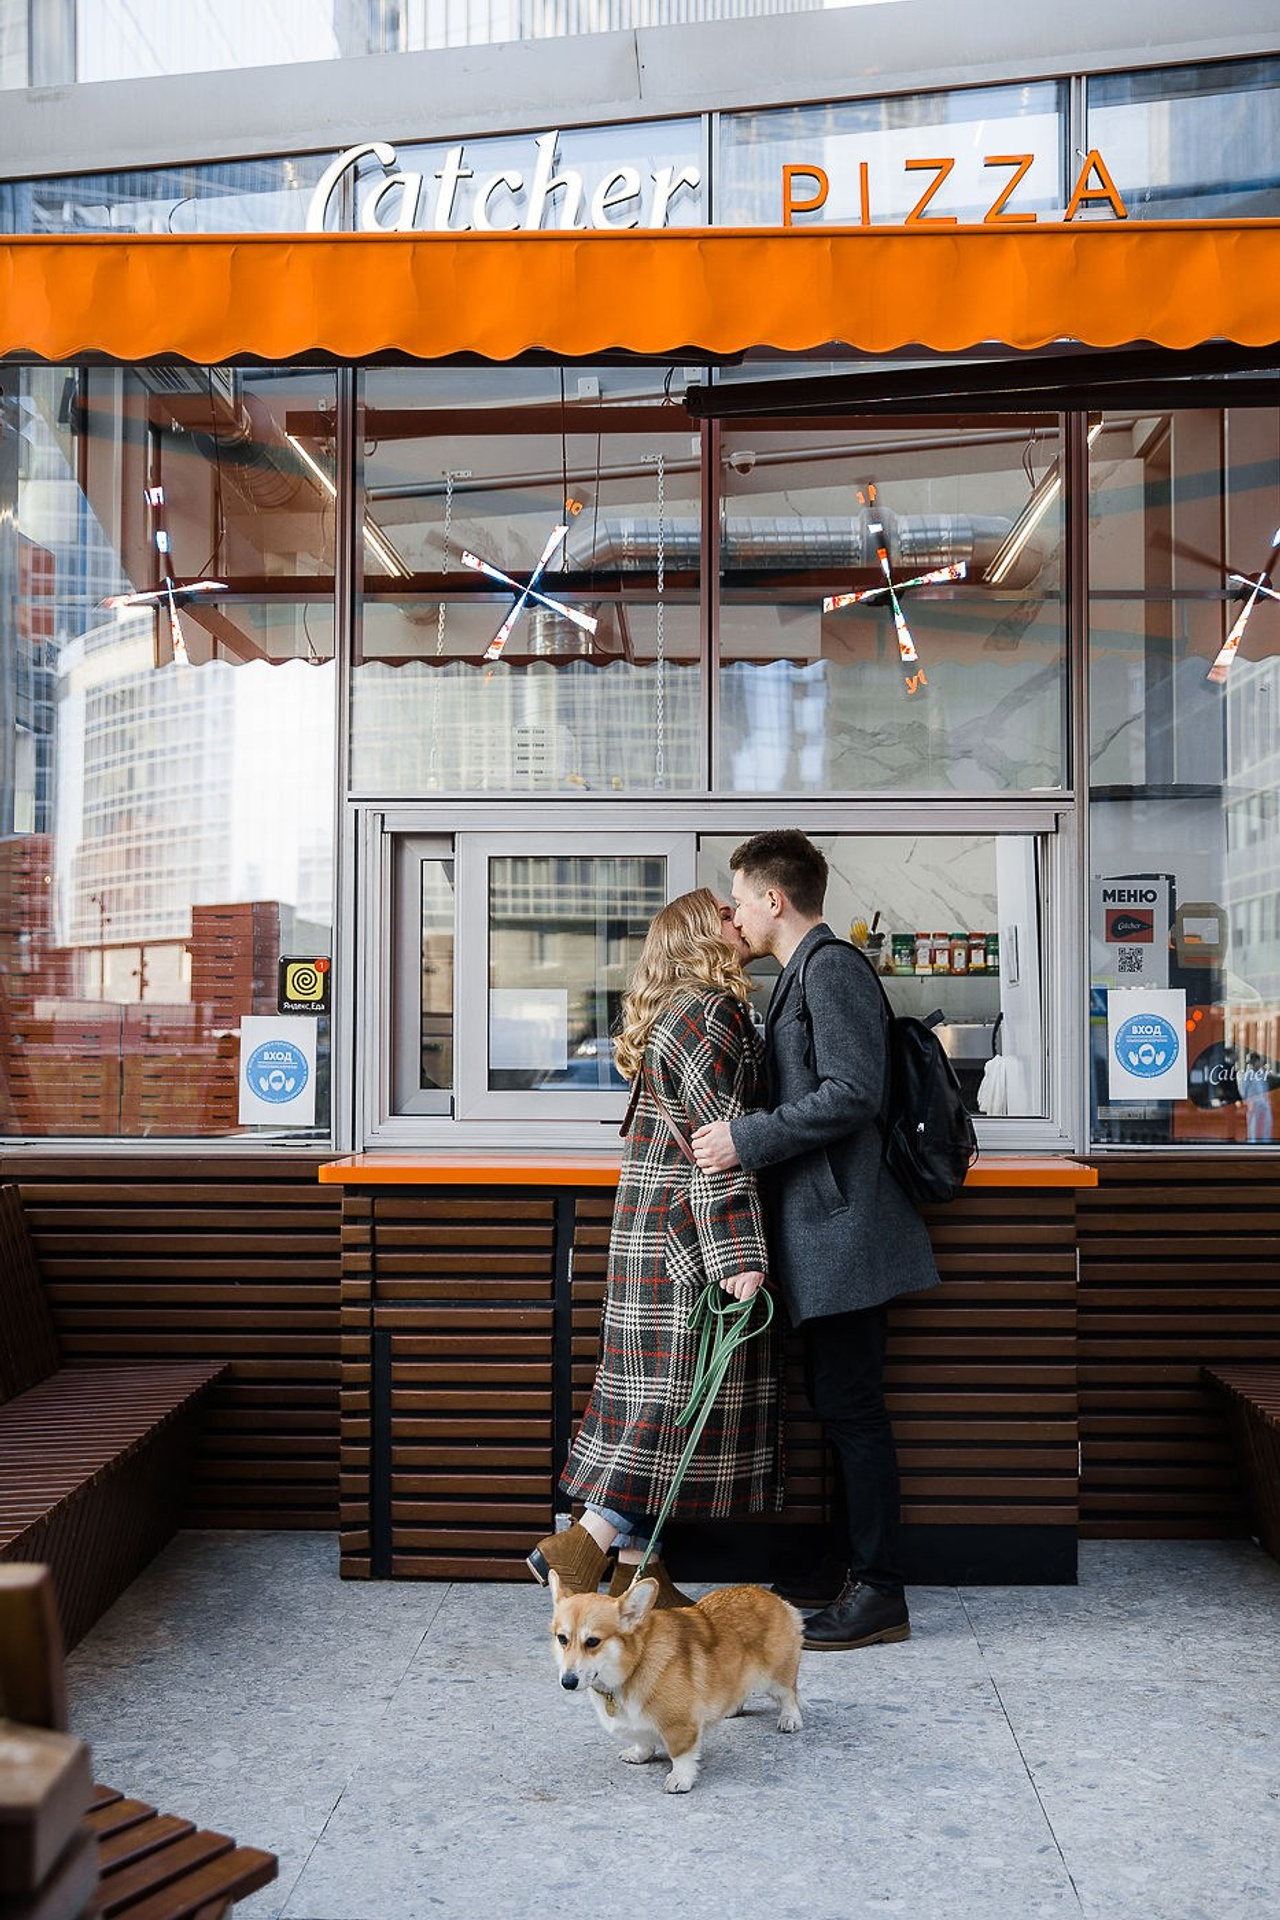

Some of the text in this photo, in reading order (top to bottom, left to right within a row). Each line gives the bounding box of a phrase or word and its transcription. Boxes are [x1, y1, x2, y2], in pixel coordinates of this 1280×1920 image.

[306, 129, 1128, 232] Catcher PIZZA
[1102, 889, 1158, 903] МЕНЮ
[1131, 1025, 1162, 1036] ВХОД
[263, 1051, 292, 1062] ВХОД
[1209, 1063, 1273, 1086] Catcher
